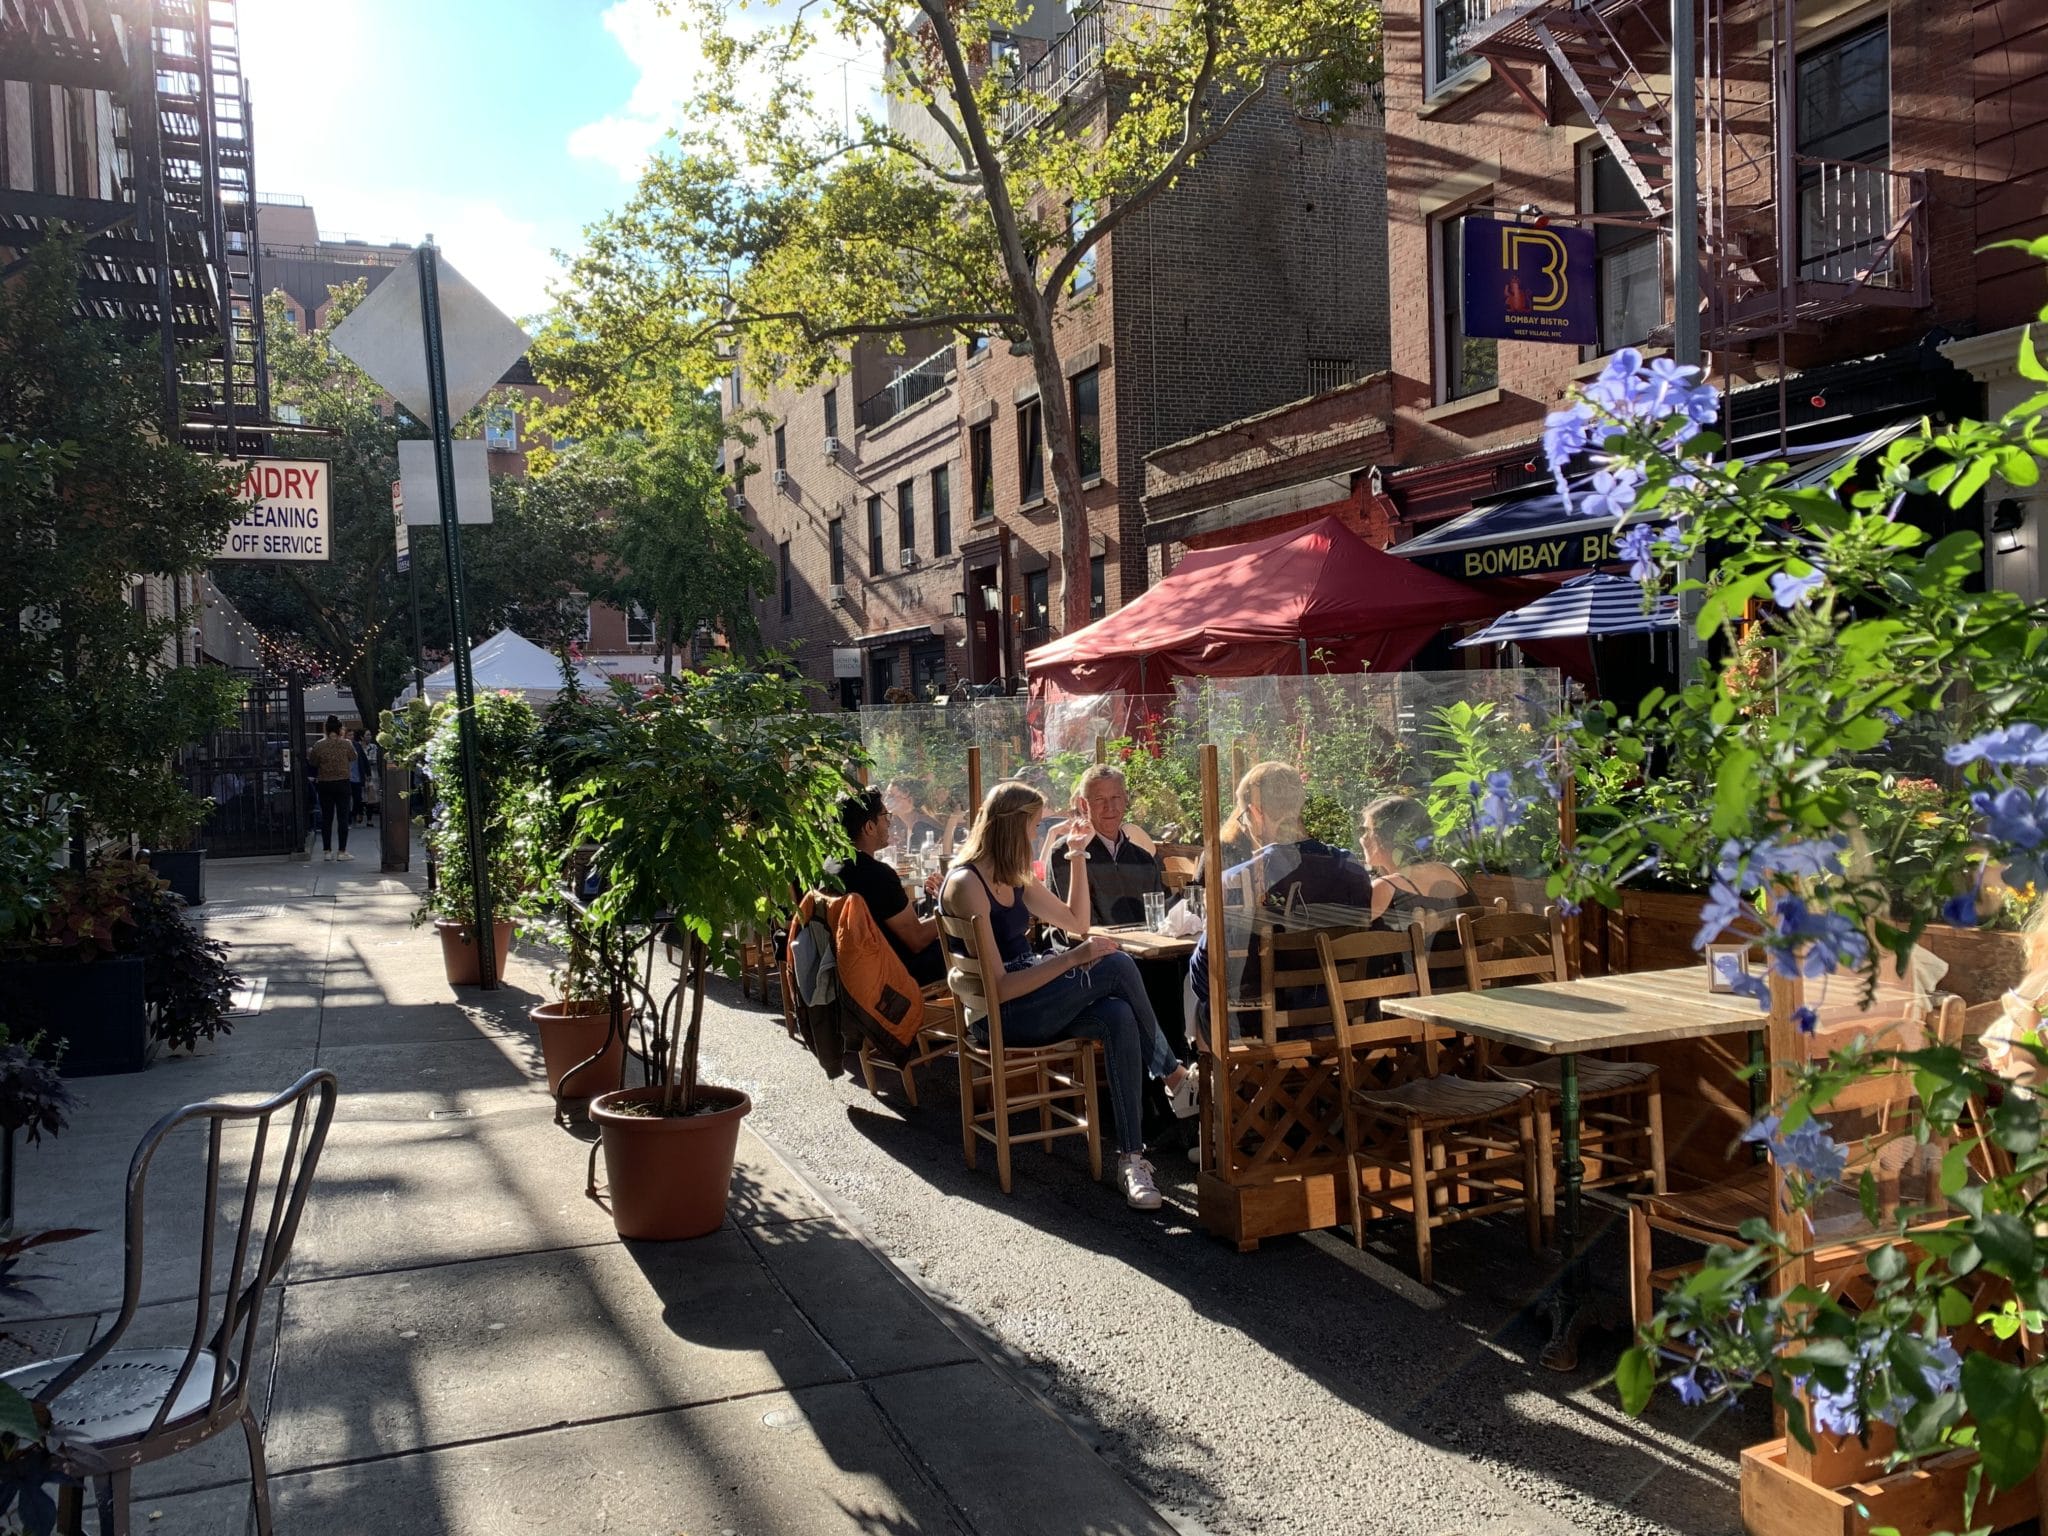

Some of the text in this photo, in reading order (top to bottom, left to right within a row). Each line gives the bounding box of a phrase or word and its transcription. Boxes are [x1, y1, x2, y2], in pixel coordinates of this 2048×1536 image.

[1504, 315, 1569, 327] BOMBAY BISTRO
[231, 534, 260, 553] OFF
[263, 535, 323, 554] SERVICE
[1464, 540, 1568, 577] BOMBAY
